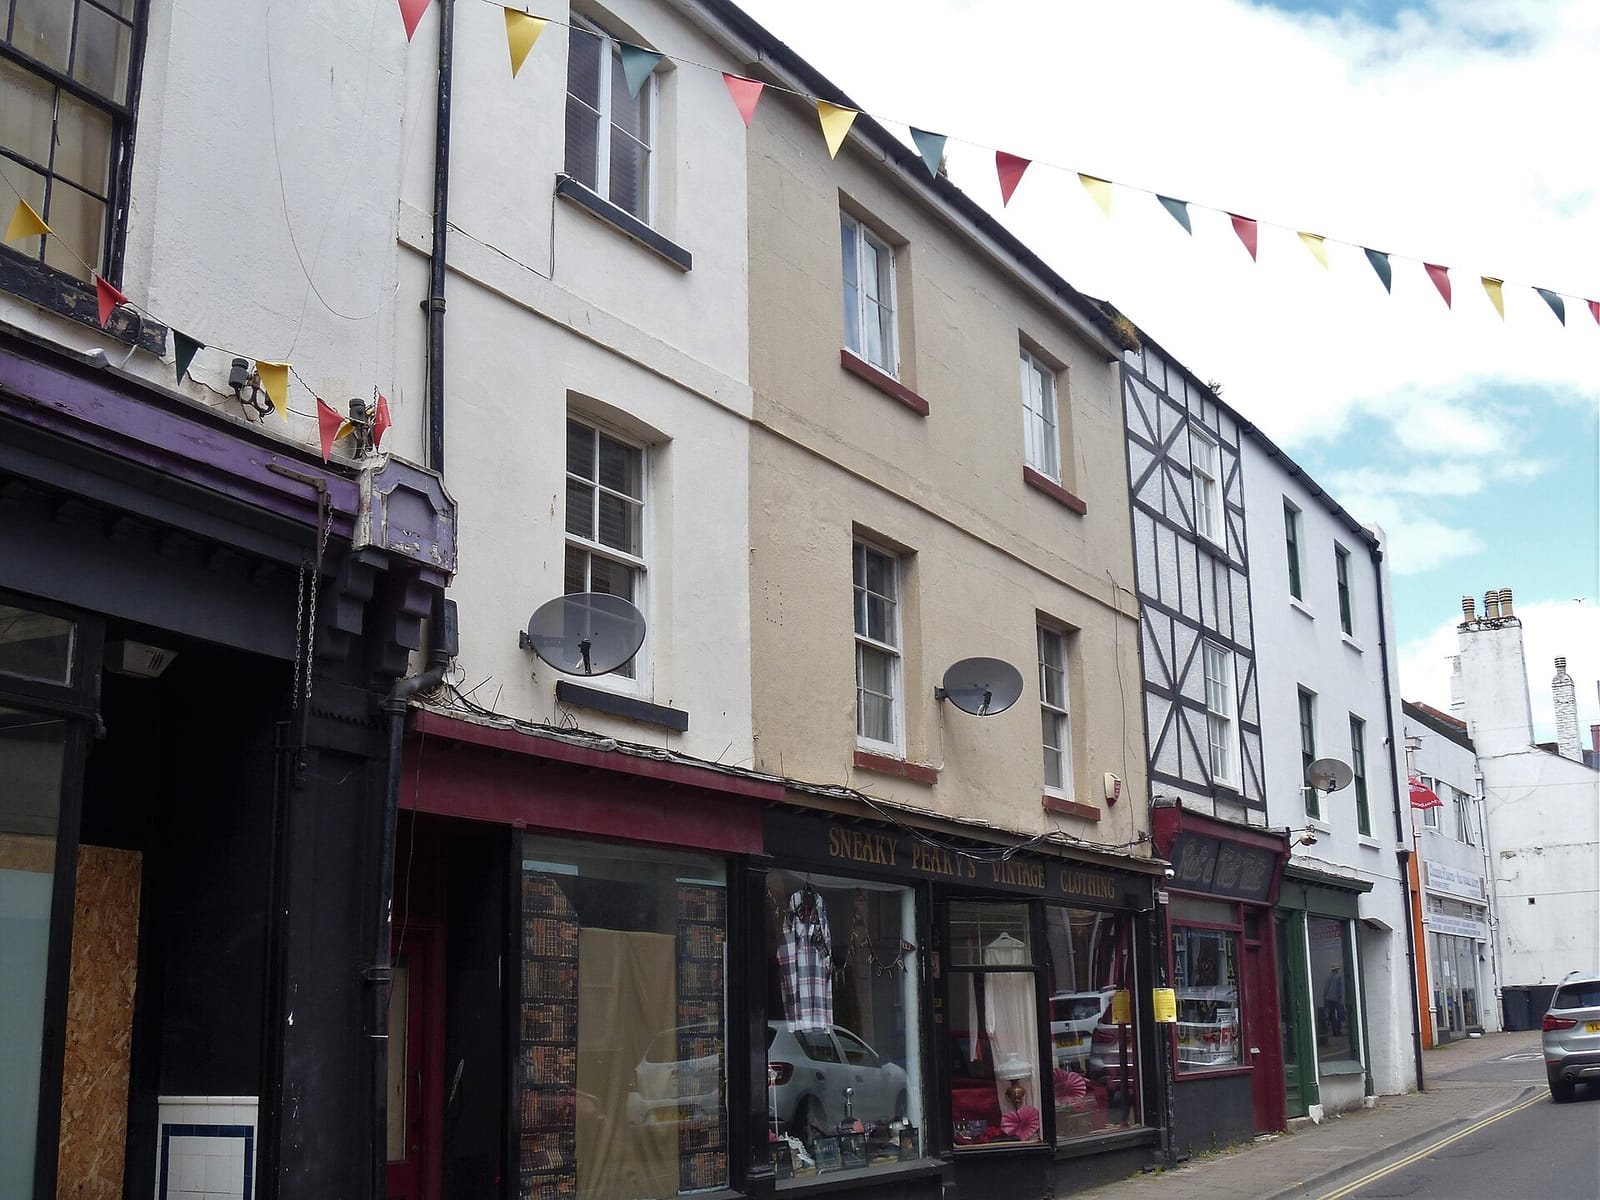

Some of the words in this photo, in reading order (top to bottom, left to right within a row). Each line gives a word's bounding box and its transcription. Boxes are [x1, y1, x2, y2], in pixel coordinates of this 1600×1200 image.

[829, 827, 898, 866] SNEAKY
[992, 858, 1046, 889] VINTAGE
[1060, 869, 1116, 899] CLOTHING
